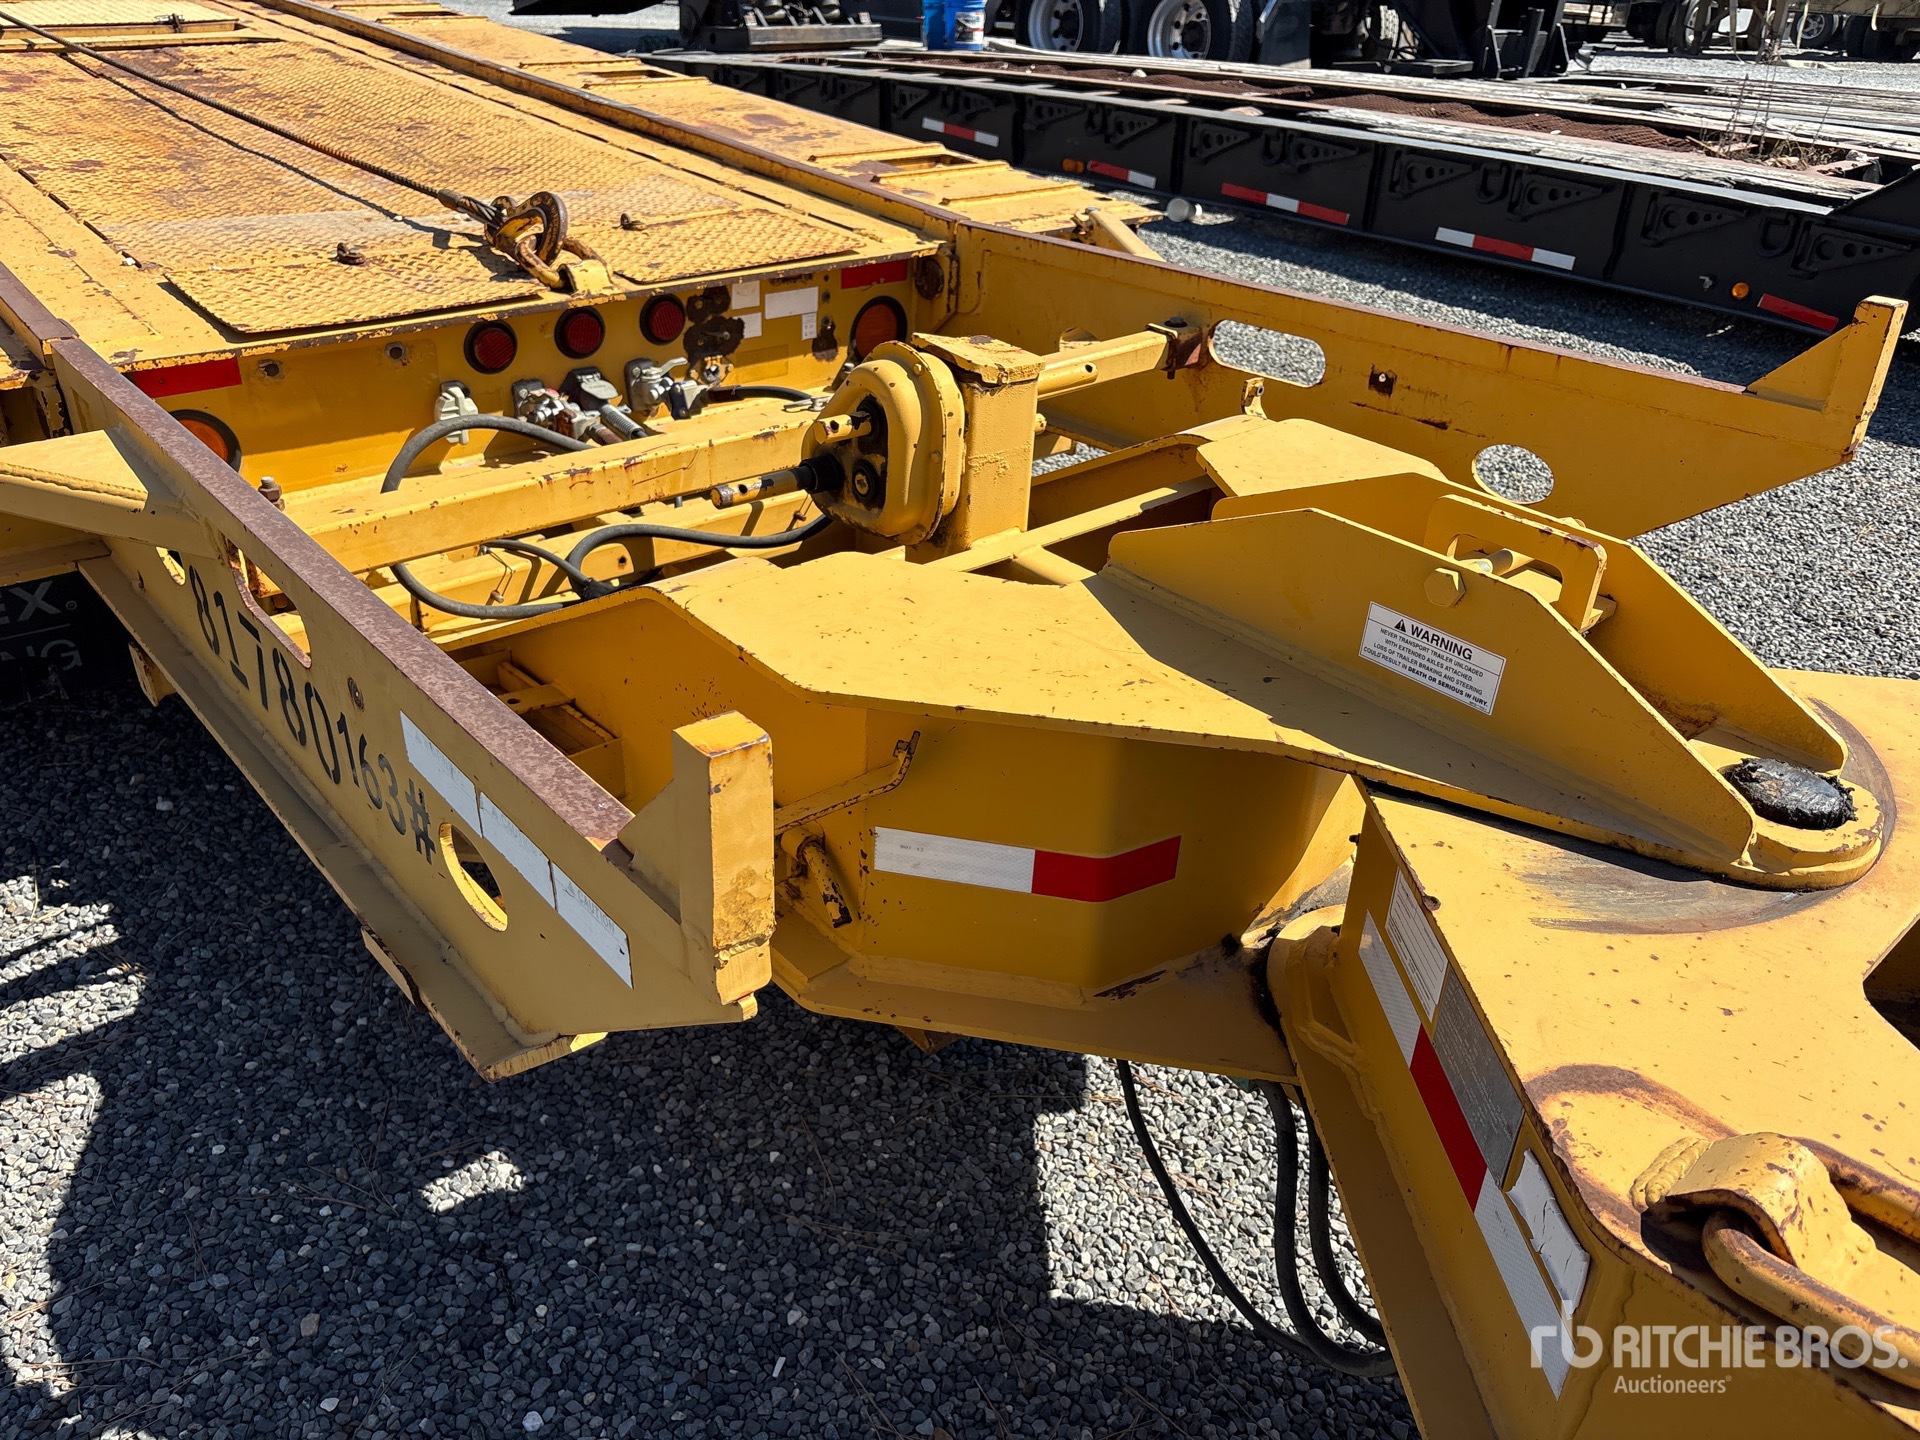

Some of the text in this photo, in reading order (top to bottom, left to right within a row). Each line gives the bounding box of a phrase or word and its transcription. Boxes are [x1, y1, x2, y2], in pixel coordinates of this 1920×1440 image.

[1380, 628, 1483, 677] NEVER TRANSPORT TRAILER UNLOADED
[1385, 639, 1473, 682] WITH EXTENDED AXLES ATTACHED.
[1411, 624, 1473, 661] WARNING
[1363, 647, 1381, 658] COULD
[1382, 654, 1401, 668] RESULT
[1408, 666, 1427, 679] DEATH
[1428, 675, 1437, 684] OR
[1438, 680, 1464, 696] SERIOUS
[1373, 642, 1483, 695] LOSS OF TRAILER BRAKING AND STEERING
